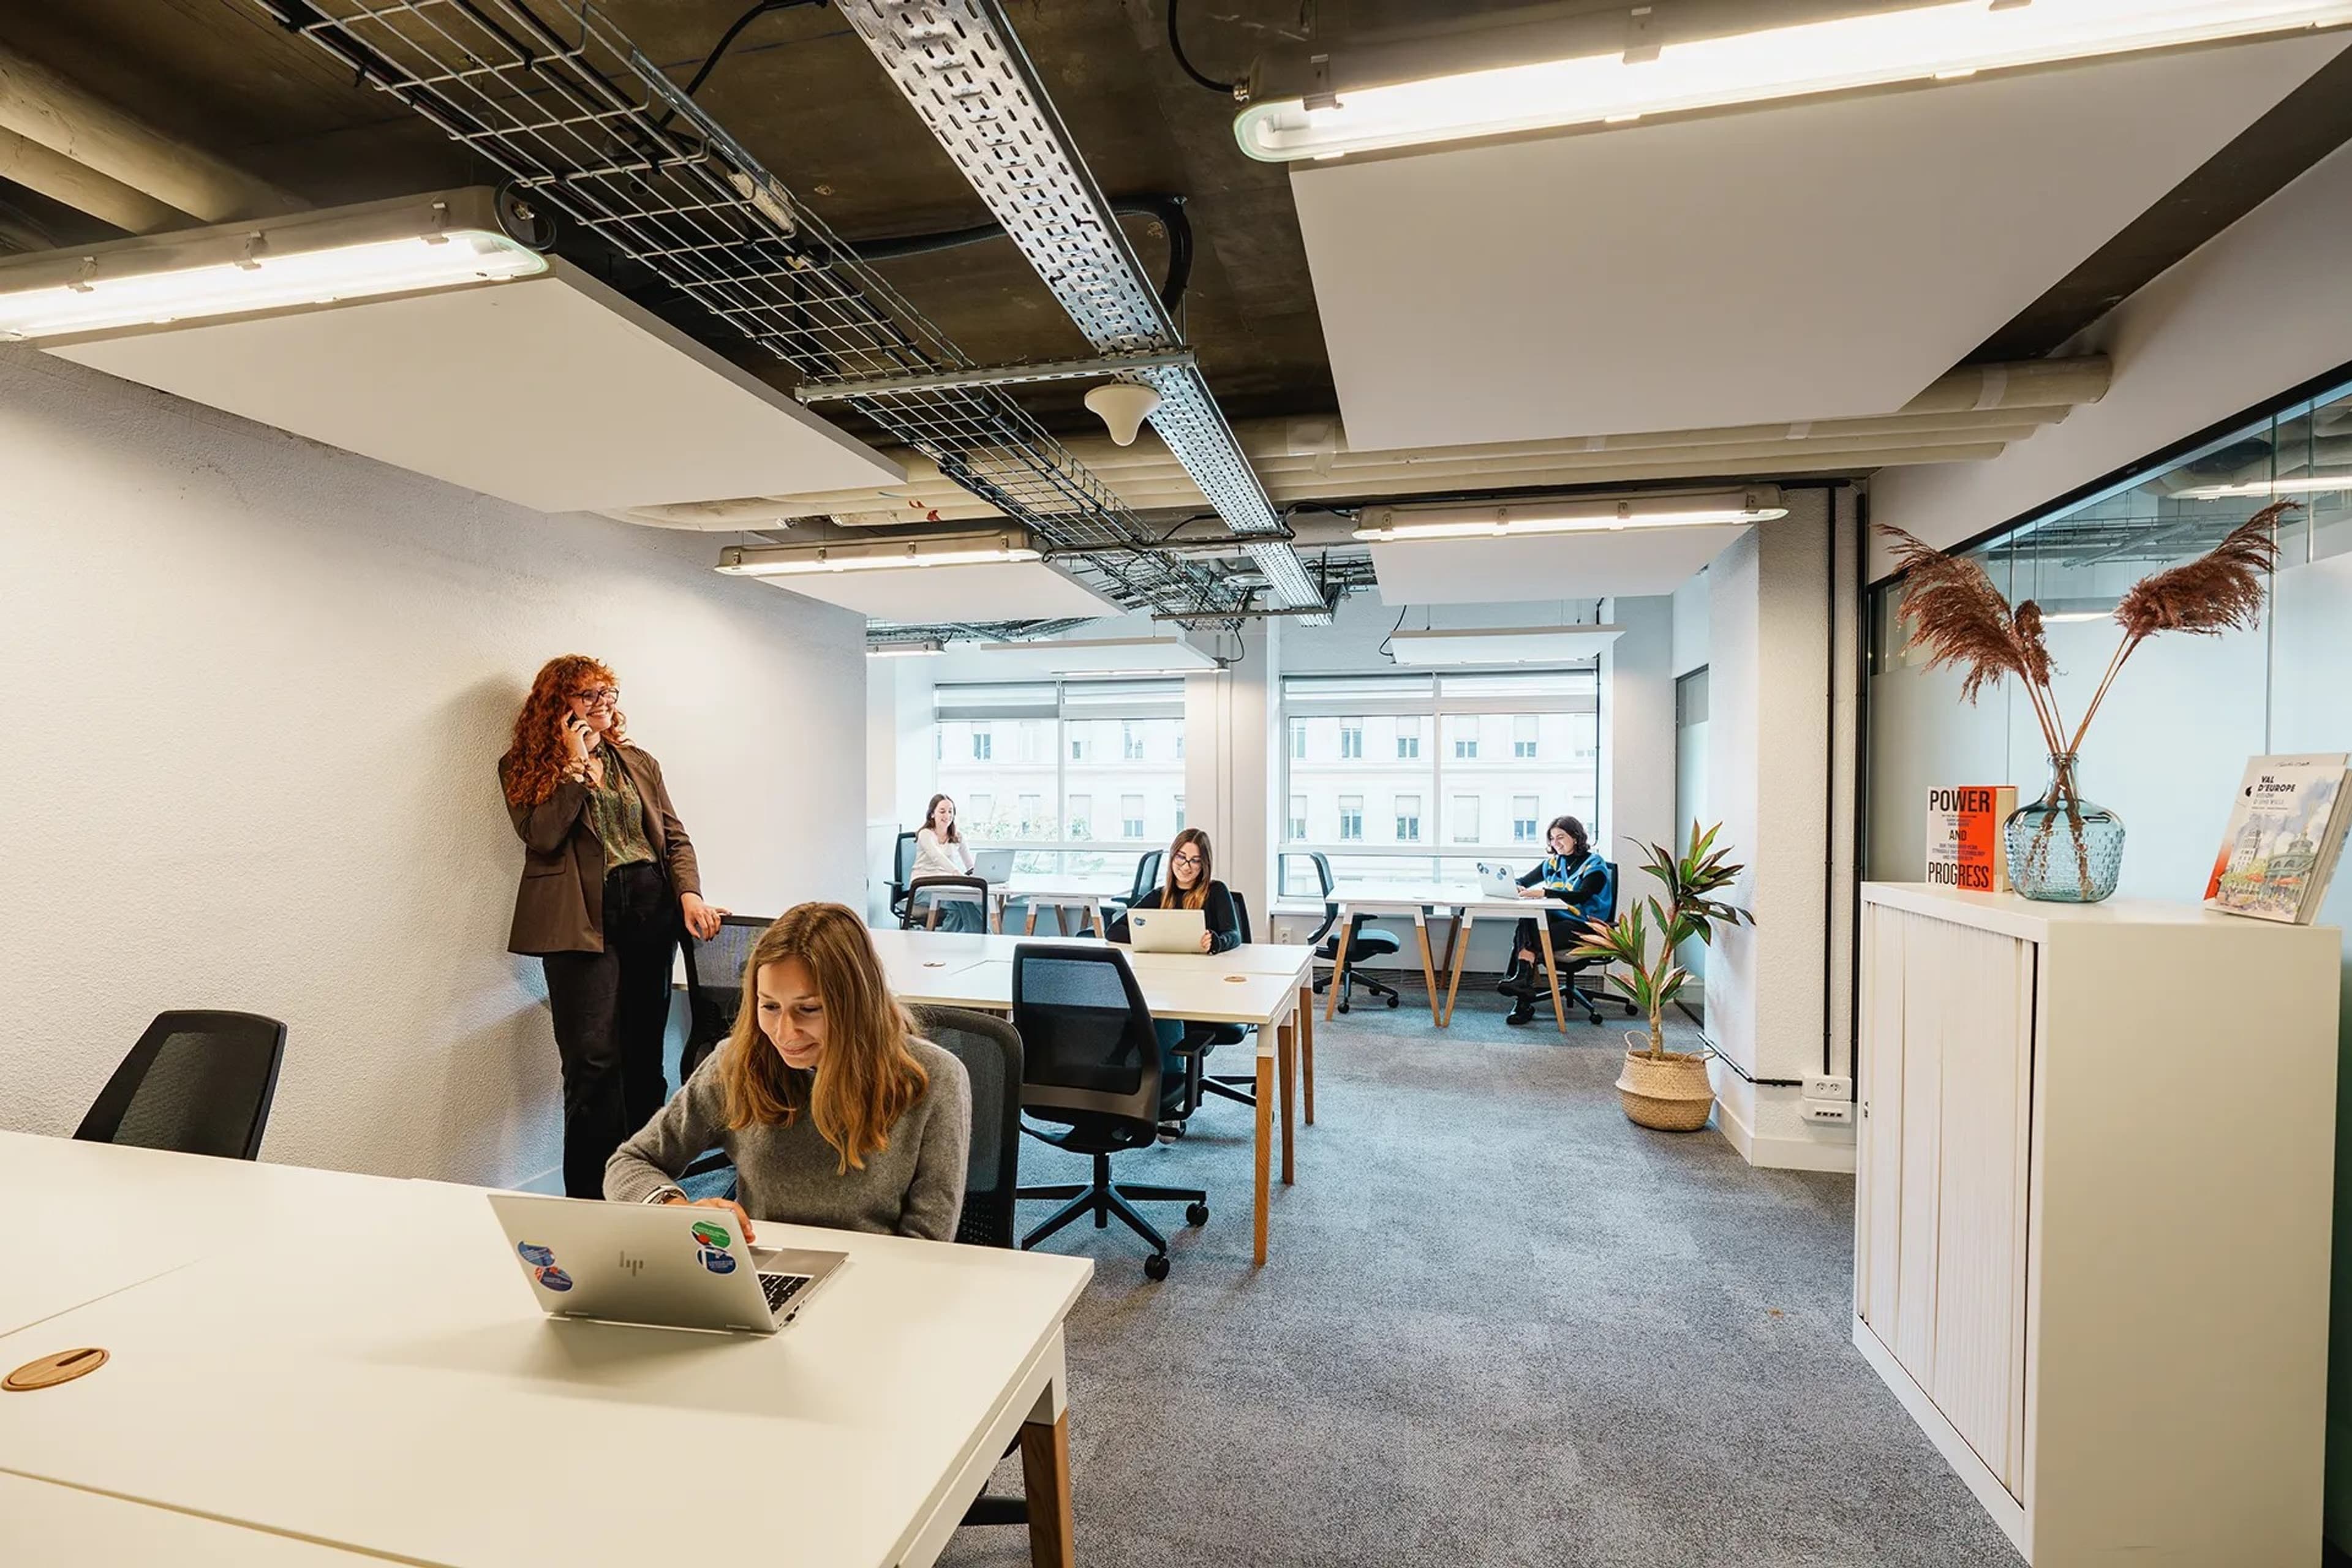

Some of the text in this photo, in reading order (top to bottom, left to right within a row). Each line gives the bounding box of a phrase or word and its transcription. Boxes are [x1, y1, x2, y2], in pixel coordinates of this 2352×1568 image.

[2257, 783, 2296, 792] D'EUROPE
[1929, 790, 1990, 813] POWER
[1949, 829, 1967, 841] AND
[1928, 861, 1989, 888] PROGRESS
[619, 1250, 644, 1277] hp
